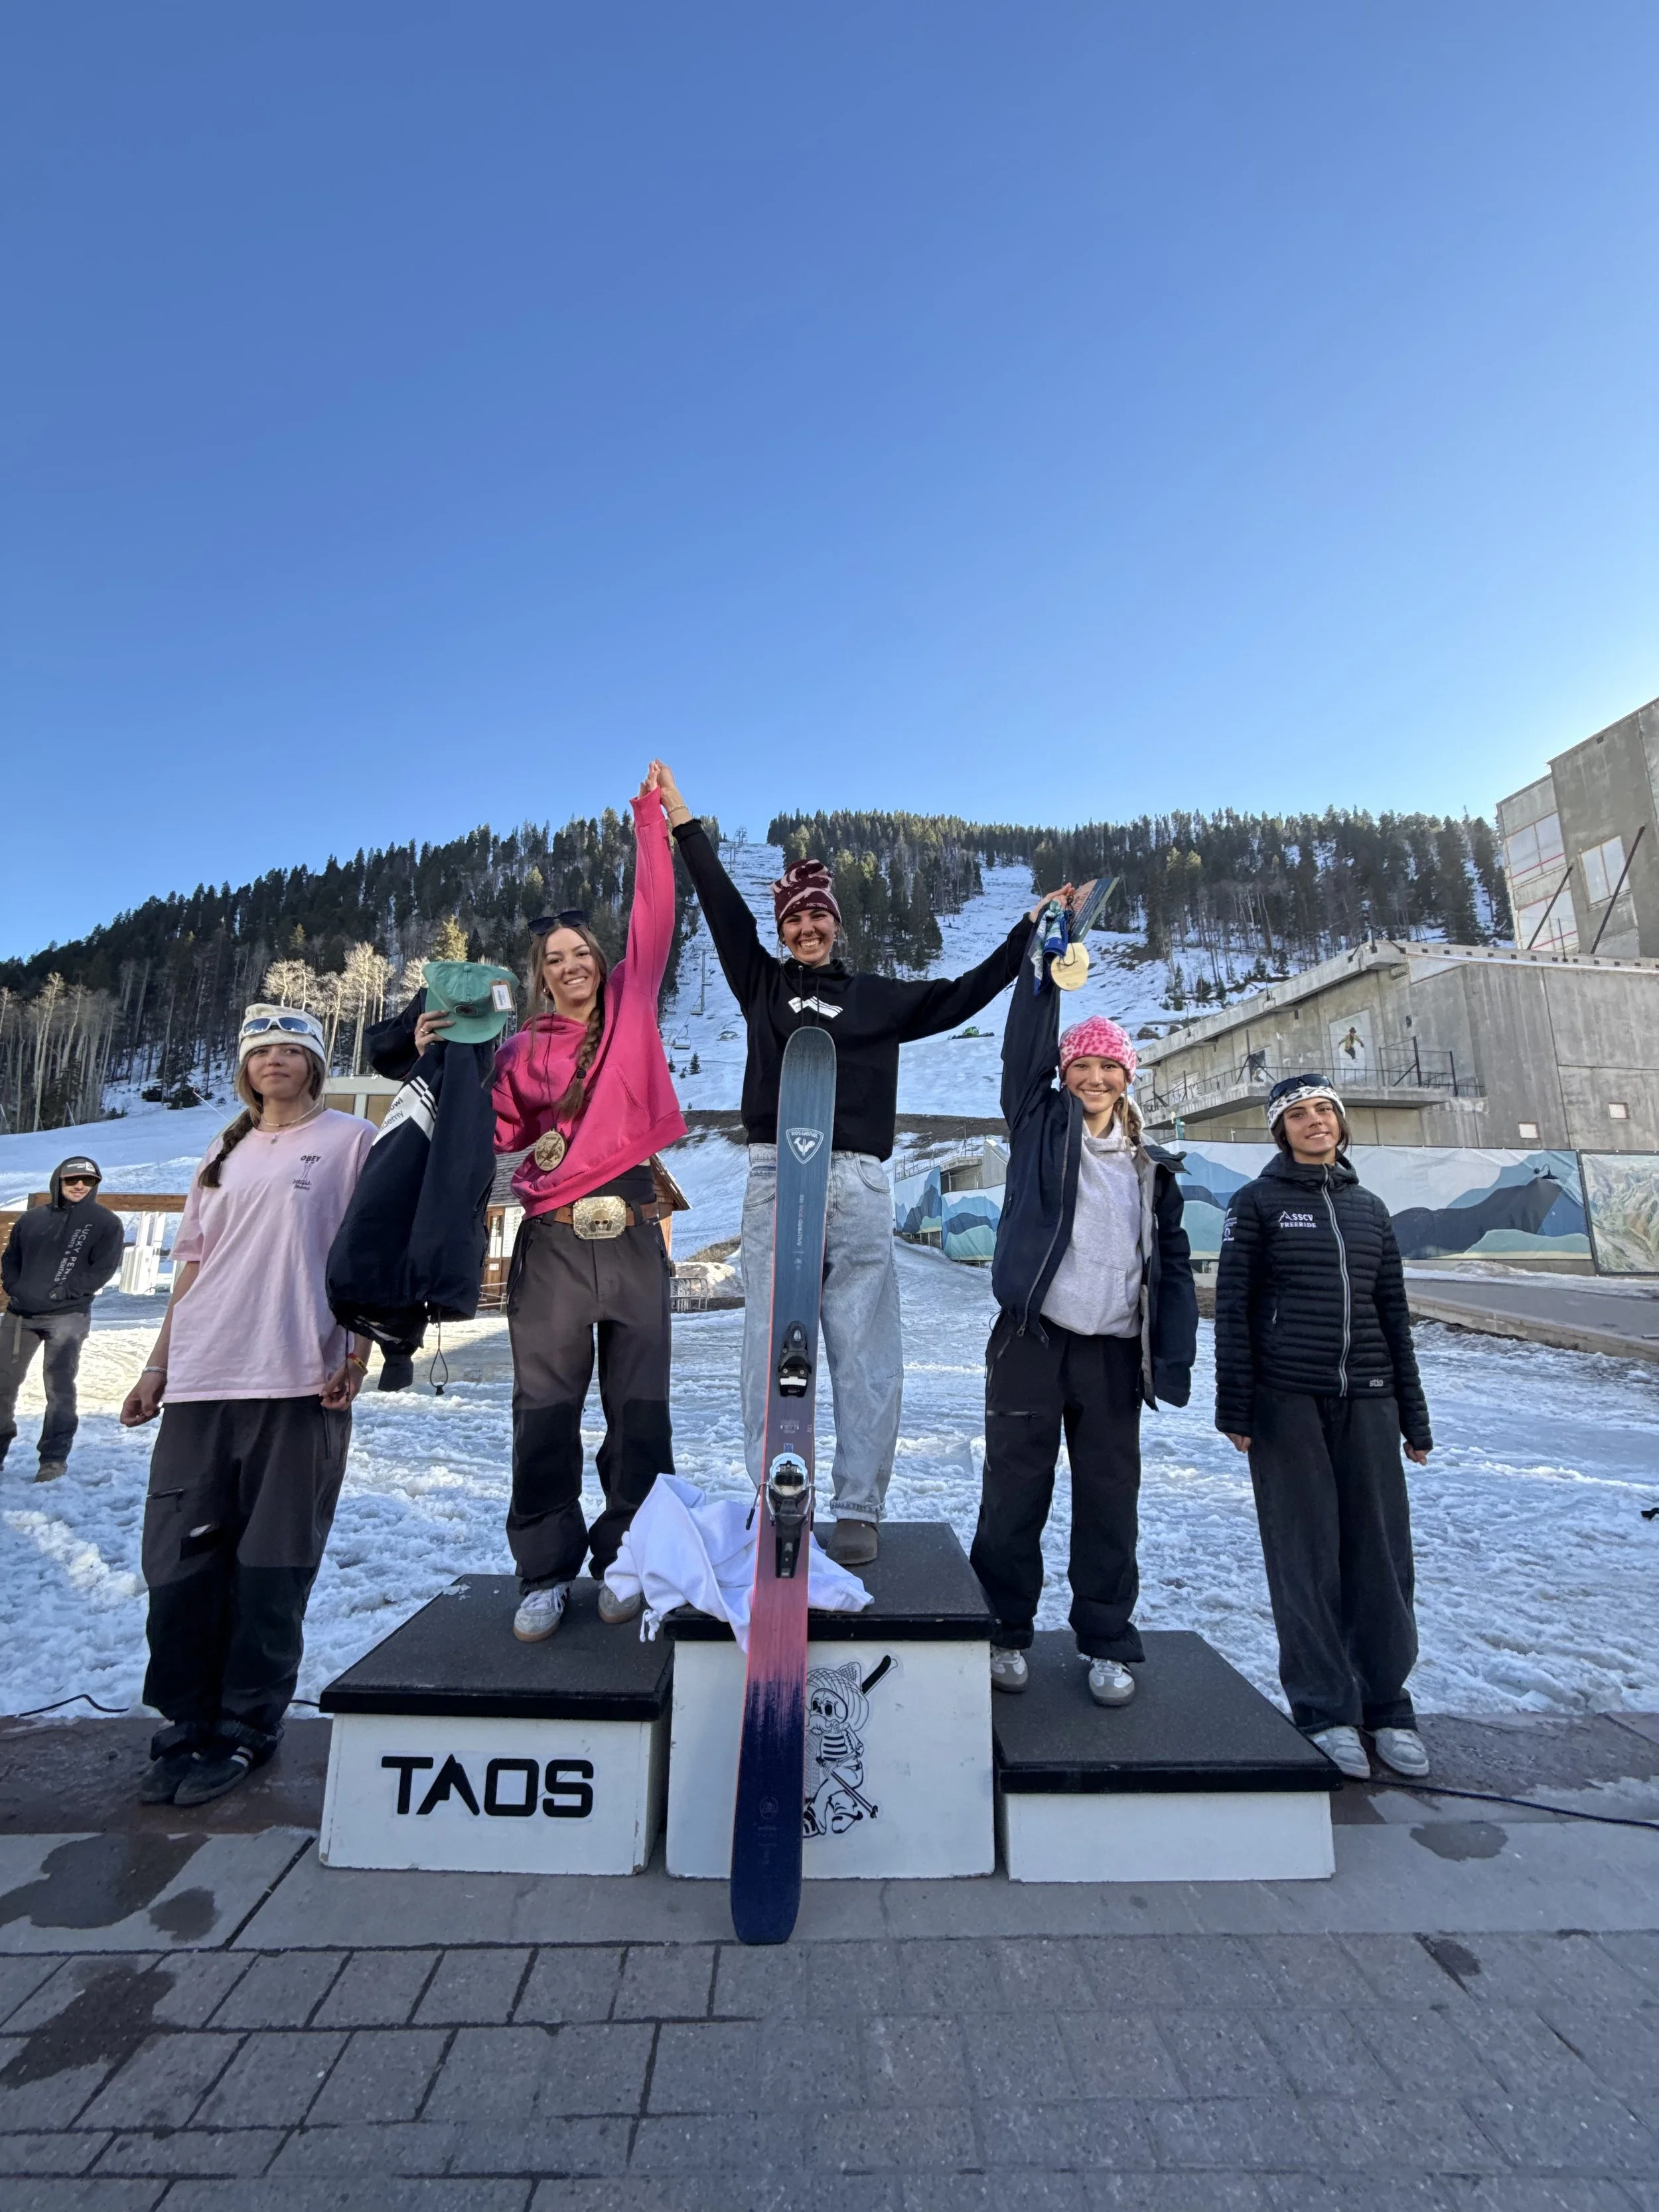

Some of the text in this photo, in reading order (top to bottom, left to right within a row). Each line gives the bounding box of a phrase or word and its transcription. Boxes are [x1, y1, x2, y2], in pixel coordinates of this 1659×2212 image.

[68, 1229, 81, 1248] EVENTS
[74, 1224, 92, 1253] LUCKY
[54, 1258, 68, 1282] RENTALS
[382, 1753, 594, 1818] TAOS
